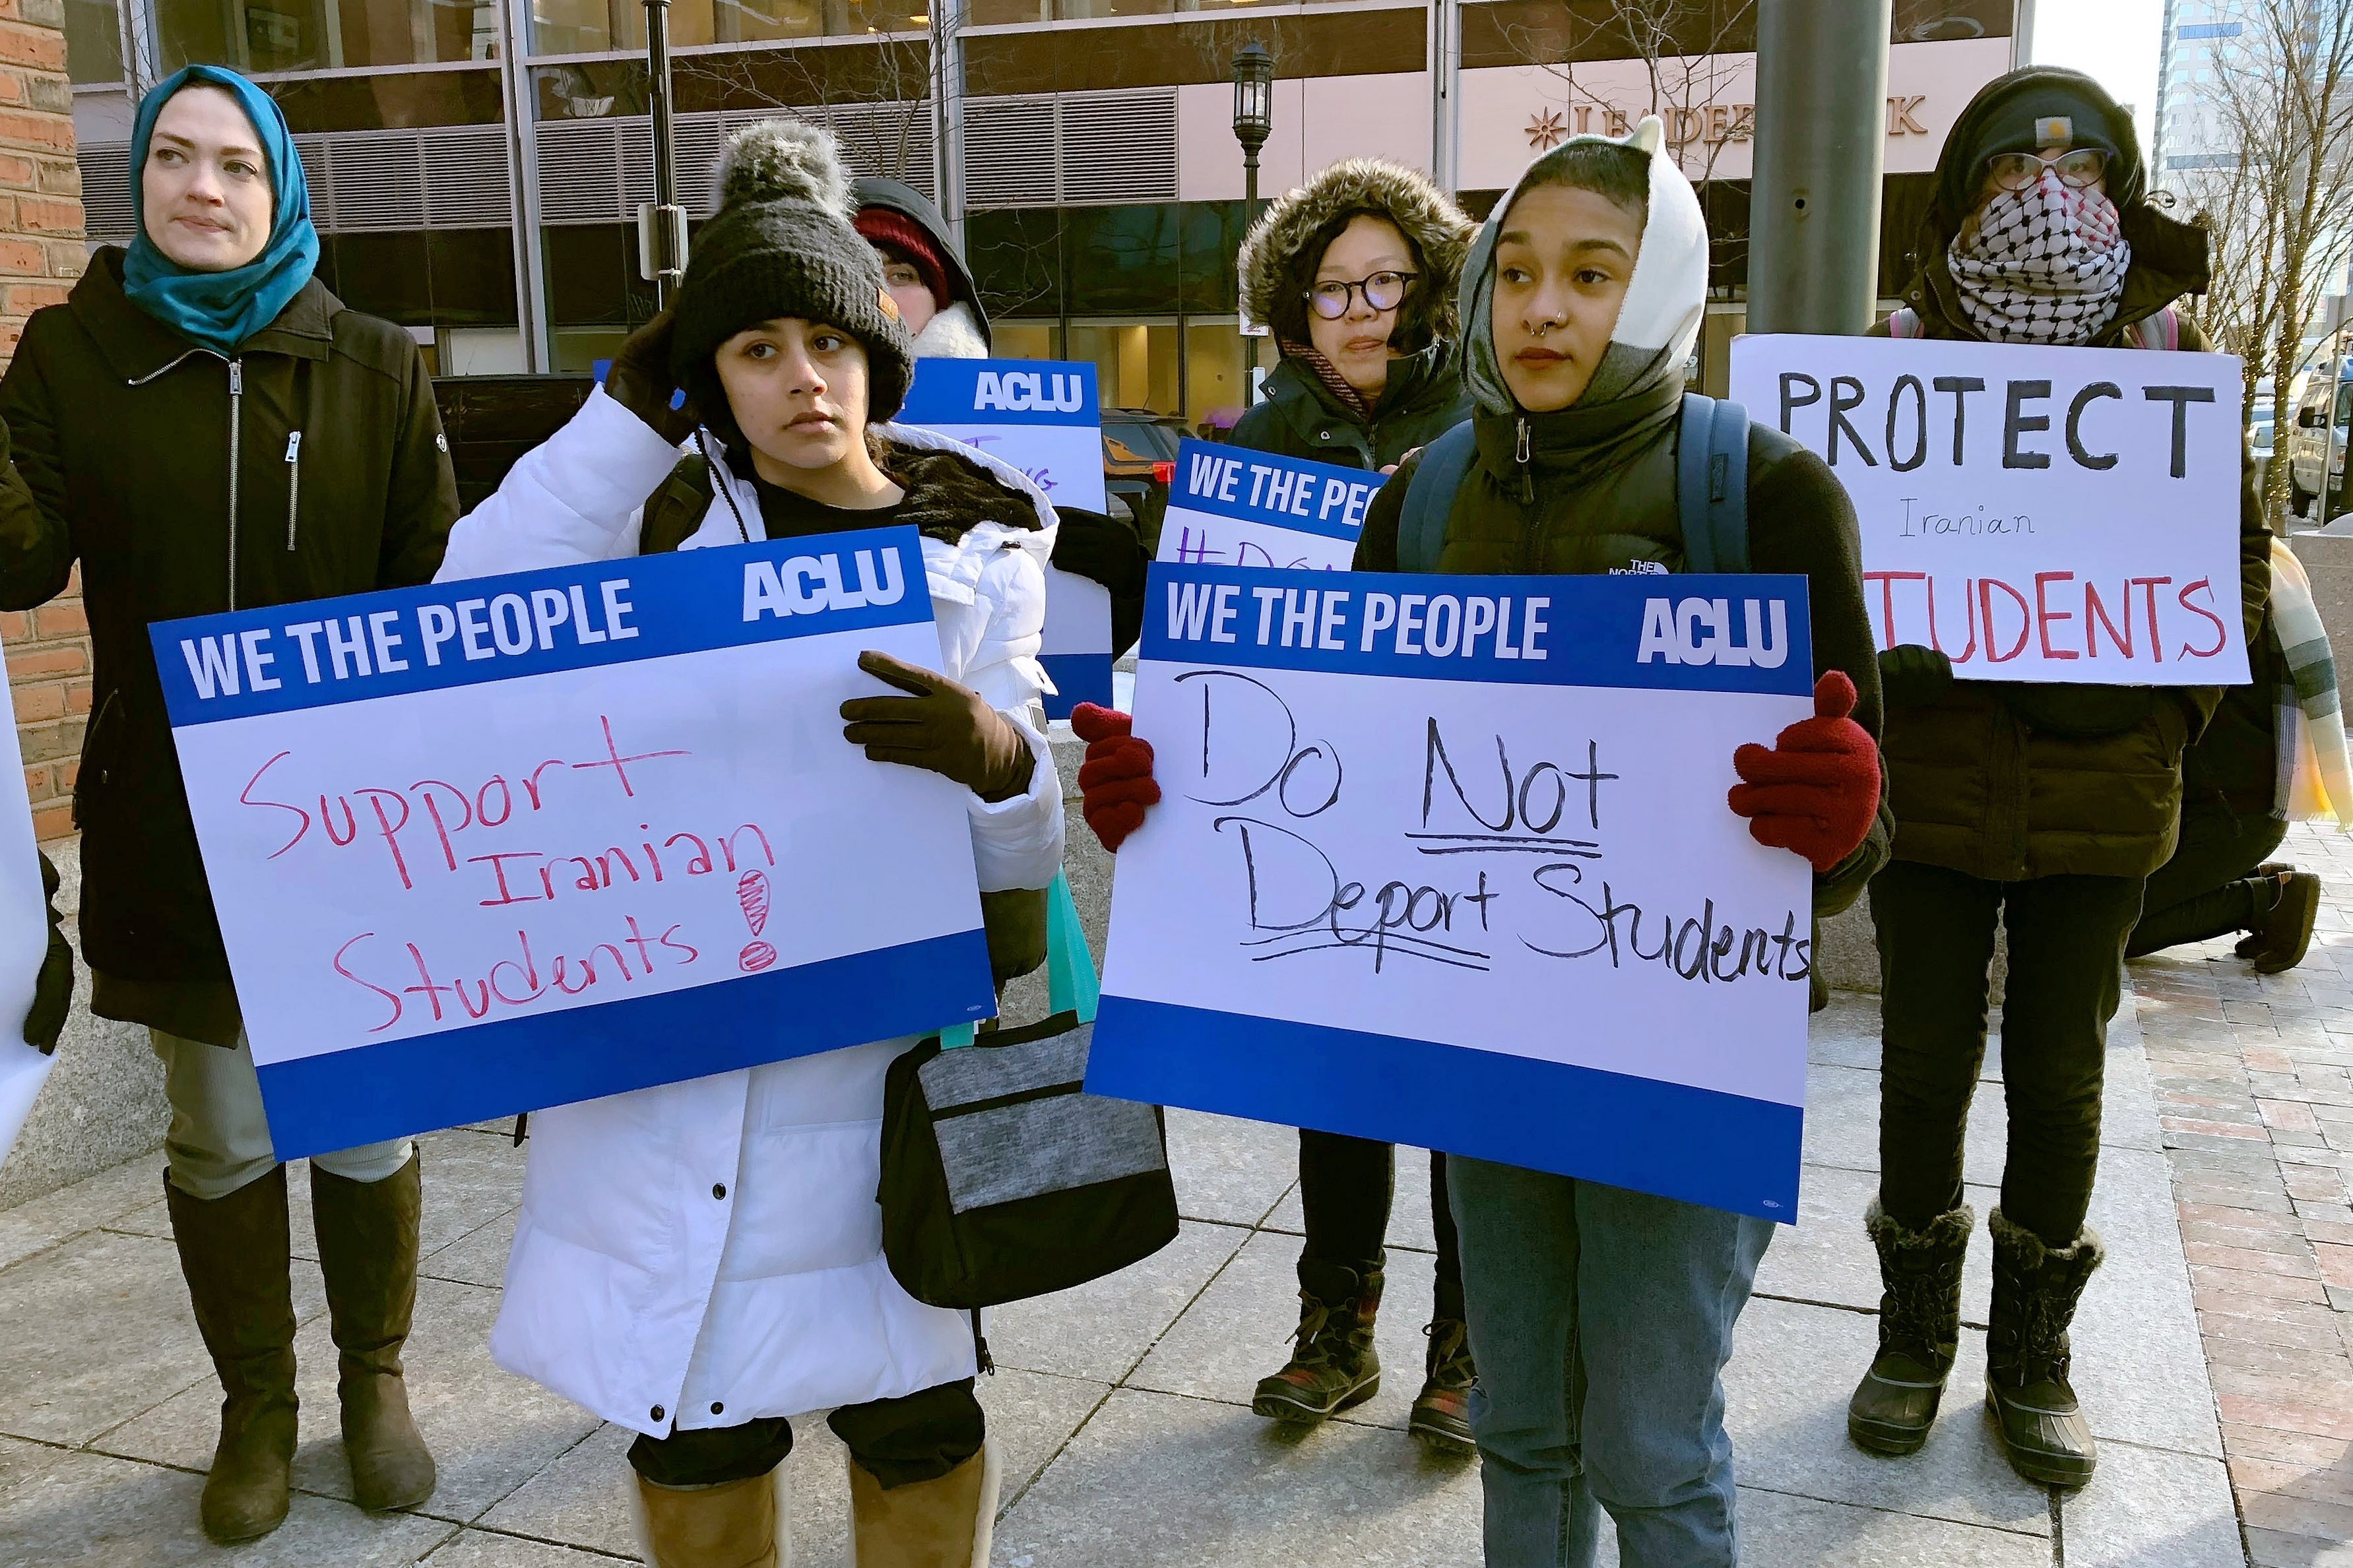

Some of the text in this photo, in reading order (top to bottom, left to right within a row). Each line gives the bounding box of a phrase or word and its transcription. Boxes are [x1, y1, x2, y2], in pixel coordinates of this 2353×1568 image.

[974, 372, 1082, 412] ACLU
[1780, 373, 2216, 479] PROTECT
[1189, 453, 1242, 502] WE
[1250, 464, 1316, 516] THE
[1900, 497, 2036, 537] Iranian
[742, 546, 905, 622] ACLU
[1630, 559, 1655, 573] THE
[181, 579, 639, 699] WE THE PEOPLE
[1168, 582, 1549, 660] WE THE PEOPLE
[1636, 597, 1788, 669] ACLU
[1864, 571, 2226, 663] TUDENTS
[1174, 670, 1619, 834] Do Not
[240, 715, 693, 890] Support
[467, 824, 775, 906] Iranian
[1213, 817, 1811, 983] Deport Students
